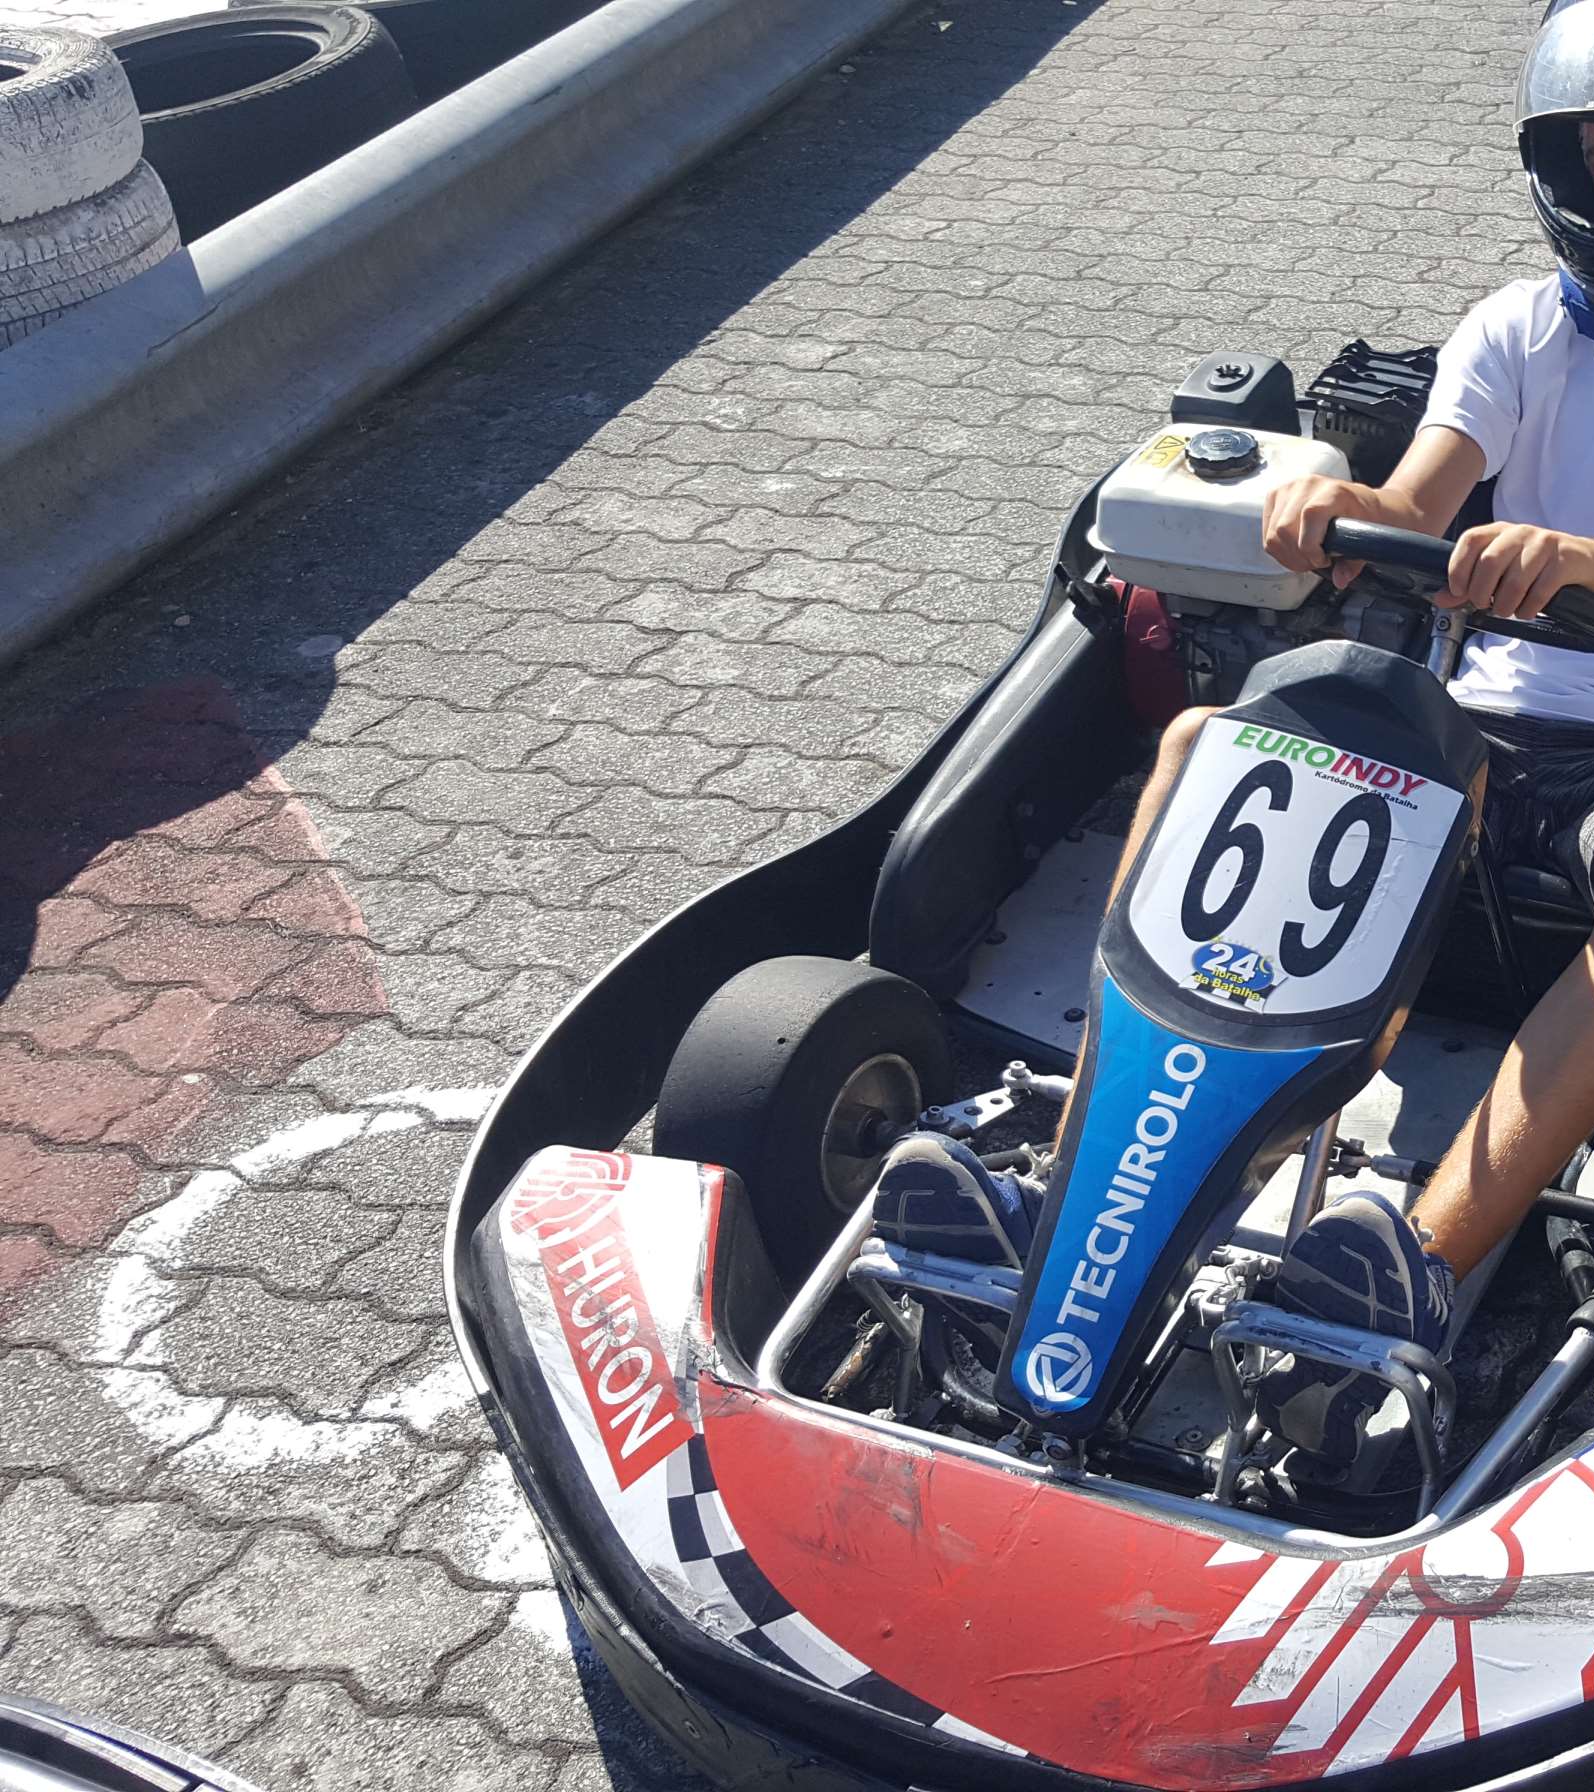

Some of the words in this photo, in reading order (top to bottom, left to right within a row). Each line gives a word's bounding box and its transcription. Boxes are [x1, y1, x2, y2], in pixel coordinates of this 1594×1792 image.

[1233, 725, 1428, 797] EUROINDY
[1314, 770, 1369, 793] Kartódromo
[1383, 792, 1418, 810] Batalha
[1181, 760, 1392, 977] 69
[1194, 973, 1209, 985] da
[1212, 979, 1261, 1001] Batalha
[1201, 943, 1259, 983] 24
[1056, 1043, 1207, 1325] TECNIROLO
[557, 1235, 674, 1460] HURON
